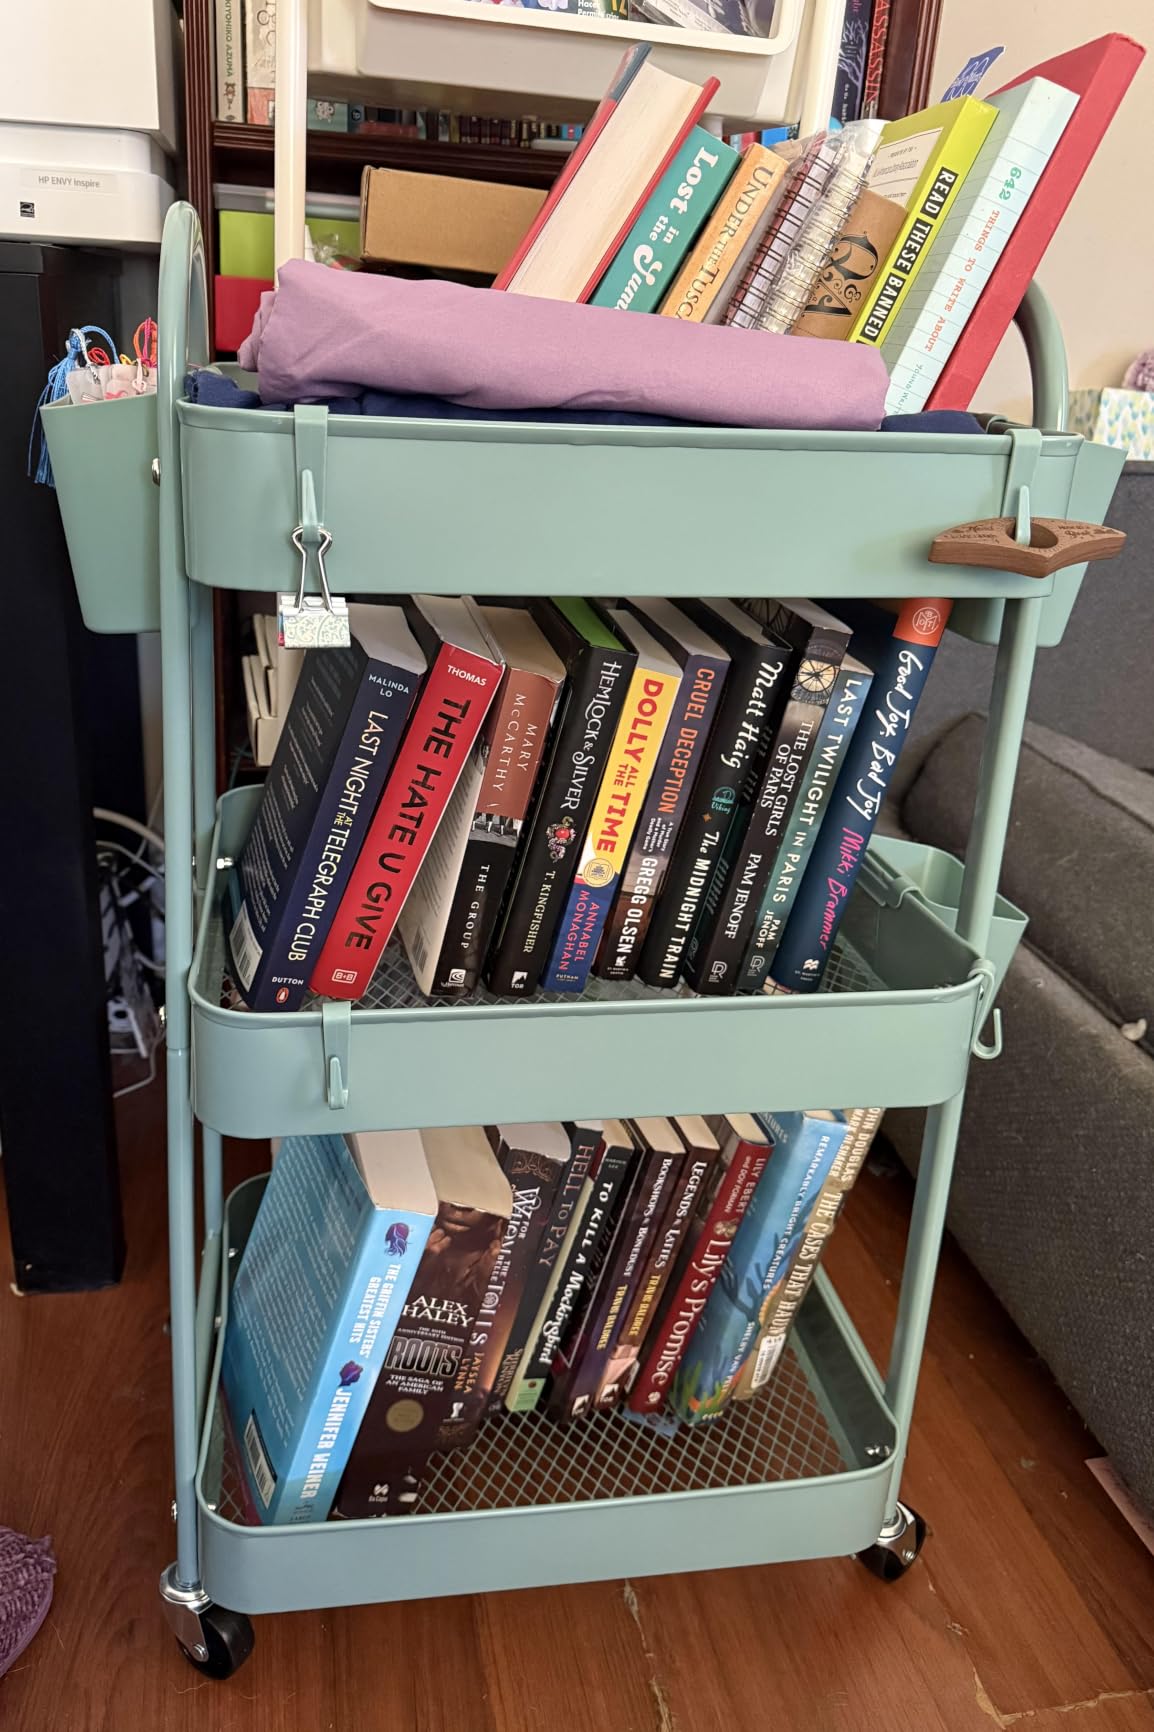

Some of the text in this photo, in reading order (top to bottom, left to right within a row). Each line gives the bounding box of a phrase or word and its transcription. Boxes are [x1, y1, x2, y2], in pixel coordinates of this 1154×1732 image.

[866, 0, 890, 102] ASSASSIN
[38, 175, 101, 189] HP ENVY Inspire
[649, 147, 719, 244] Lost in the
[720, 166, 775, 238] UNDER
[708, 239, 728, 265] THE
[864, 170, 955, 338] READ THESE BANNED
[924, 167, 1022, 353] 642 THINGS TO WRITE ABOUT
[368, 674, 409, 694] MALINDA
[379, 688, 393, 698] LO
[447, 664, 488, 687] THOMAS
[359, 710, 389, 756] LAST
[423, 698, 472, 760] THE
[560, 661, 622, 810] HEMLOCK & SILVER
[720, 661, 784, 769] Matt Haig
[846, 650, 925, 821] Good Bad Joy
[516, 723, 539, 772] MARY
[596, 678, 664, 853] DOLLY ALL THE TIME
[657, 668, 715, 814] CRUEL DECEPTION
[339, 756, 374, 815] NIGHT
[760, 744, 791, 809] OF PARIS
[765, 720, 815, 837] THE LOST GIRLS
[772, 679, 863, 903] LAST TWILIGHT IN PARIS
[333, 811, 344, 826] THE
[343, 815, 353, 828] AT
[388, 764, 442, 846] HATE
[711, 801, 731, 815] Viking
[302, 828, 350, 920] TELEGRAPH
[378, 852, 406, 874] U
[631, 857, 658, 905] GREGG
[461, 864, 490, 949] THE GROUP
[523, 870, 556, 953] T. KINGFISHER
[659, 831, 720, 979] The MIDNIGHT TRAIN
[724, 852, 763, 940] PAM JENOFF
[819, 826, 865, 950] Mikki Brammer
[344, 881, 392, 950] GIVE
[559, 890, 590, 971] MONAGHAN
[574, 902, 600, 962] ANNABEL
[616, 908, 643, 954] OLSEN
[755, 910, 775, 949] JENOFF
[766, 918, 781, 941] PAM
[288, 922, 316, 962] CLUB
[271, 976, 304, 986] DUTTON
[849, 1109, 865, 1134] MARK
[841, 1133, 869, 1183] DOUGLAS
[538, 1144, 595, 1267] HELL TO PAY
[724, 1184, 740, 1213] FORMAN
[736, 1158, 766, 1213] LILY EBERT
[518, 1220, 530, 1239] FOR
[623, 1158, 673, 1277] BOOKSHOPS BONEDUST
[654, 1160, 708, 1269] LEGENDS LATTES
[763, 1135, 830, 1290] REMARKABLY BRIGHT CREATURES
[500, 1260, 511, 1278] THE
[784, 1192, 842, 1298] THE CASES THAT
[385, 1263, 402, 1282] THE
[538, 1181, 614, 1365] TO KILL A Mockingbird
[643, 1274, 662, 1301] TRAVIS
[349, 1276, 382, 1344] GREATEST HITS
[372, 1282, 394, 1318] GRIFFIN
[402, 1304, 475, 1328] HALEY
[412, 1295, 469, 1316] ALEX
[610, 1284, 628, 1311] TRAVIS
[651, 1239, 731, 1386] Lily's Promise
[384, 1335, 463, 1377] ROOTS
[738, 1321, 755, 1352] SHELBY
[389, 1373, 407, 1381] THE
[407, 1376, 430, 1384] SAGA
[400, 1380, 444, 1392] AMERICAN
[454, 1358, 471, 1391] LYNN
[464, 1352, 485, 1393] JAYSEA
[729, 1354, 742, 1374] VAN
[398, 1386, 429, 1395] FAMILY
[317, 1387, 352, 1449] JENNIFER
[300, 1452, 331, 1499] WEINER
